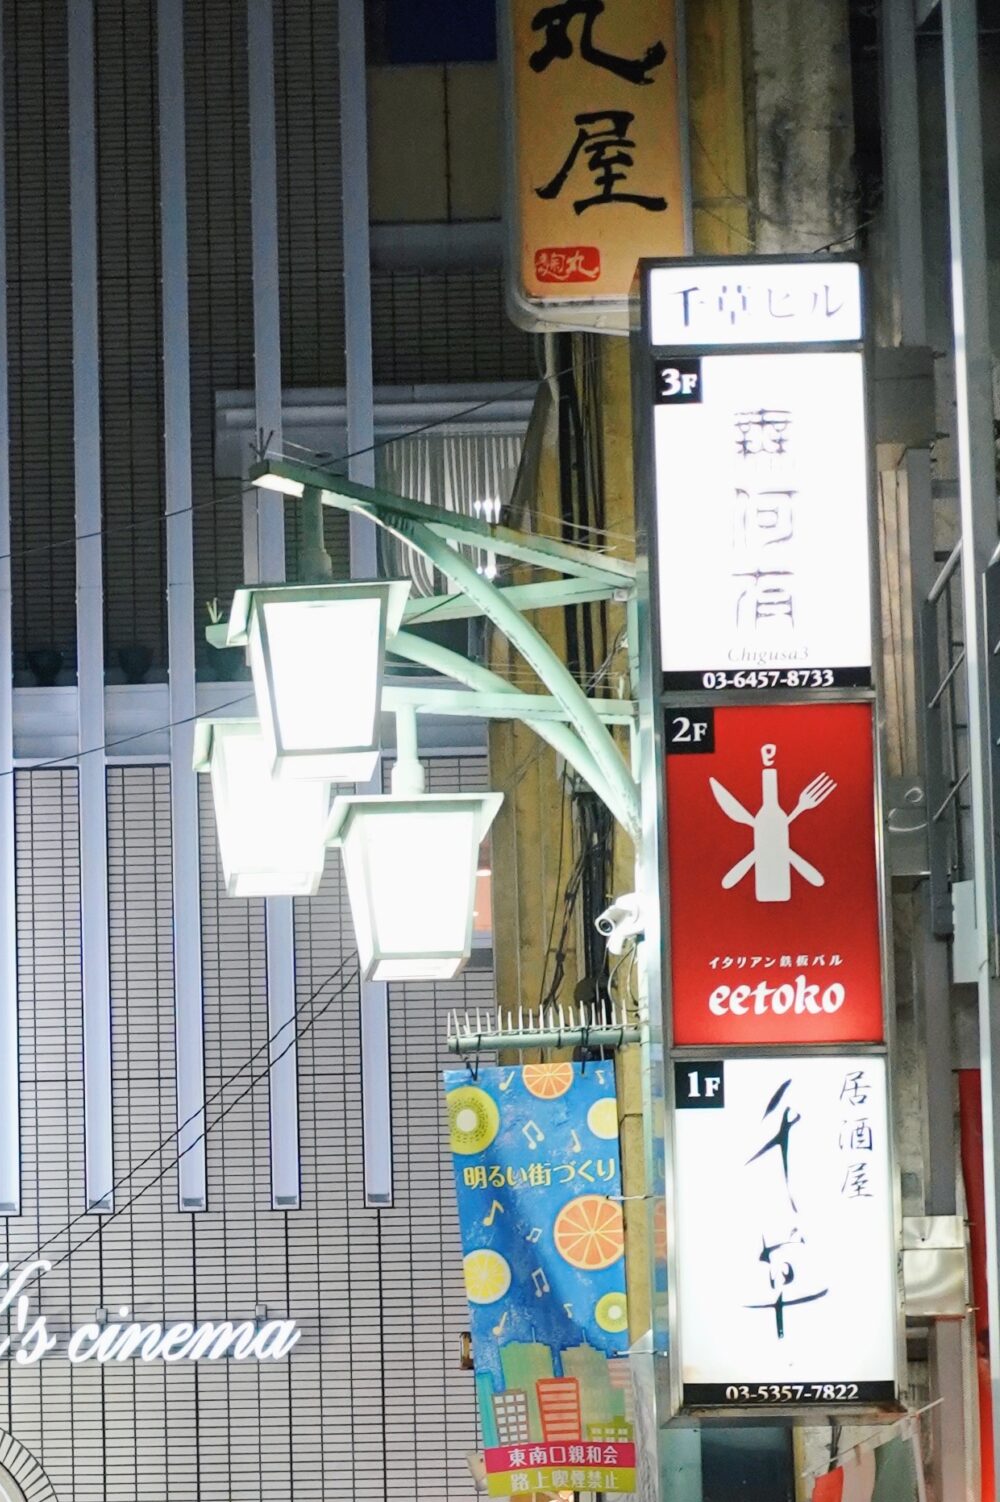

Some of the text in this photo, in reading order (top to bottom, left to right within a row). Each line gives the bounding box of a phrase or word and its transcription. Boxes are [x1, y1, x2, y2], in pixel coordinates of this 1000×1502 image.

[661, 368, 698, 396] 3F
[702, 669, 835, 689] 03-6457-8733
[671, 716, 708, 742] 2F
[708, 954, 843, 969] イタリアン鉄板バル
[708, 974, 846, 1016] eetoko
[687, 1071, 721, 1097] 1F
[839, 1070, 874, 1198] 居酒屋
[463, 1158, 616, 1190] 明るい街づくり
[67, 1307, 302, 1363] cinema
[725, 1383, 859, 1402] 03-5357-7822
[507, 1445, 618, 1467] 東南口親和会
[510, 1470, 619, 1492] 路上喫煙禁止
